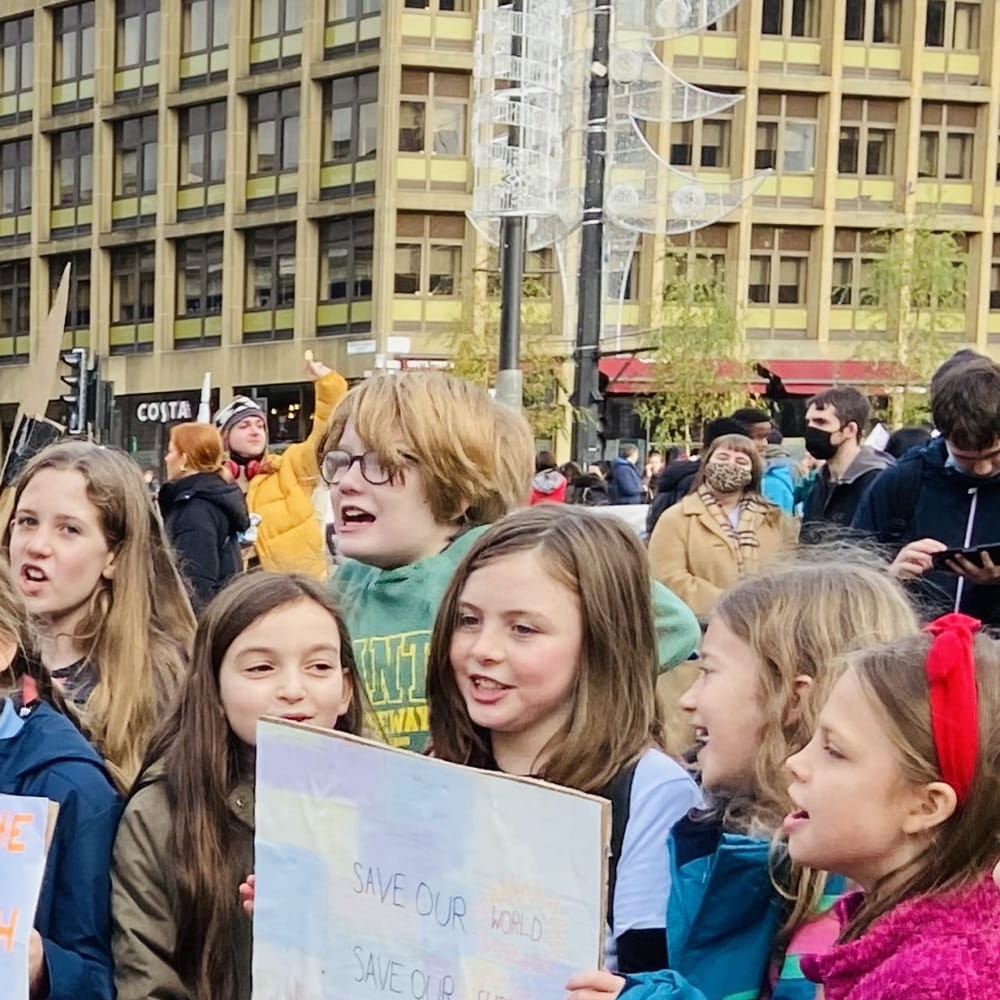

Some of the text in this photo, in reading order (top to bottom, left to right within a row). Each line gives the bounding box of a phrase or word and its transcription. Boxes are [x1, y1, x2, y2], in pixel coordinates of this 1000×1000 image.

[136, 400, 193, 422] COSTA
[353, 862, 543, 942] SAVE OUR WORLD
[353, 945, 405, 994] SAVE
